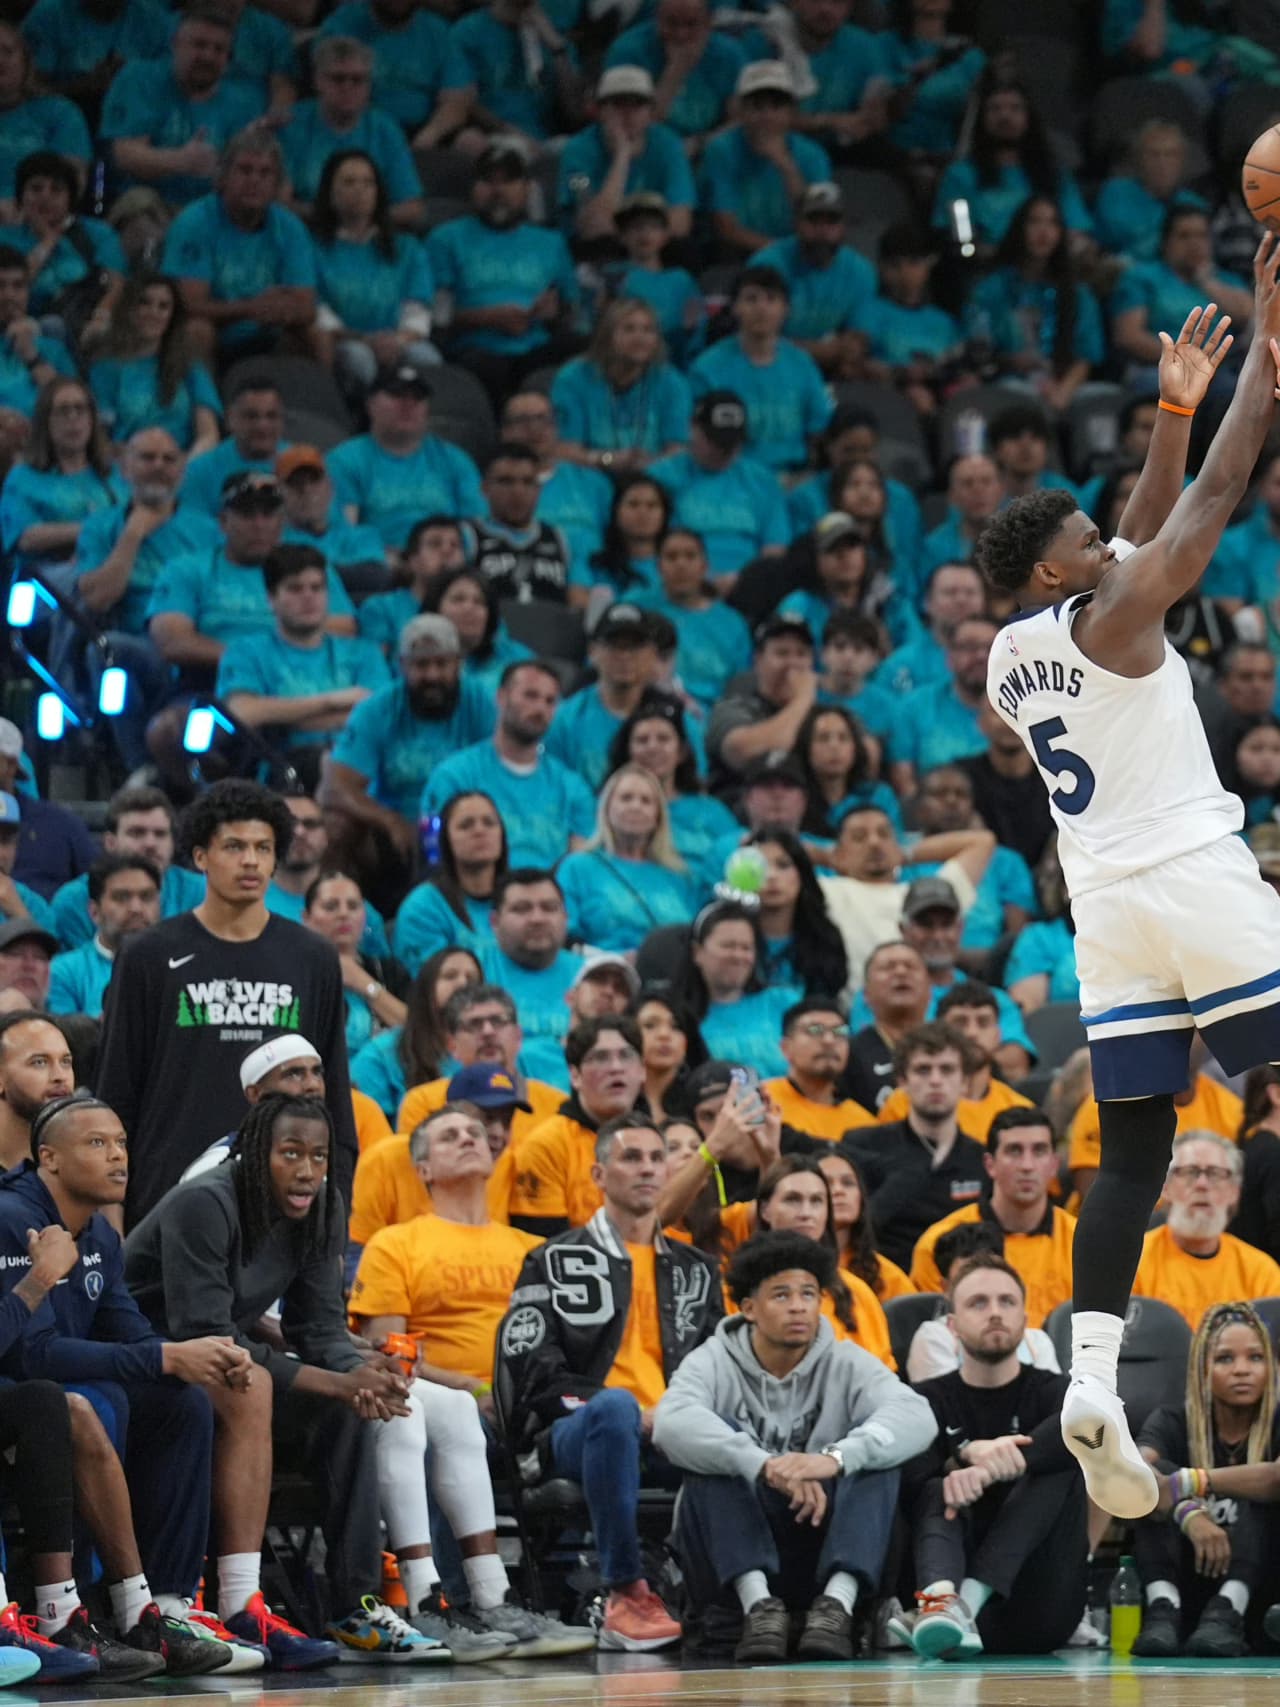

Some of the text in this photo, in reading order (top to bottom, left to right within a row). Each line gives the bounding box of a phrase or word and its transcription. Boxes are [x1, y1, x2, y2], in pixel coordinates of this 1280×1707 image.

[998, 660, 1085, 721] EDWARDS
[1028, 715, 1096, 816] 5
[207, 1002, 277, 1026] BACK
[7, 1256, 33, 1267] UHC
[442, 1264, 518, 1292] SPUR
[545, 1244, 615, 1326] S
